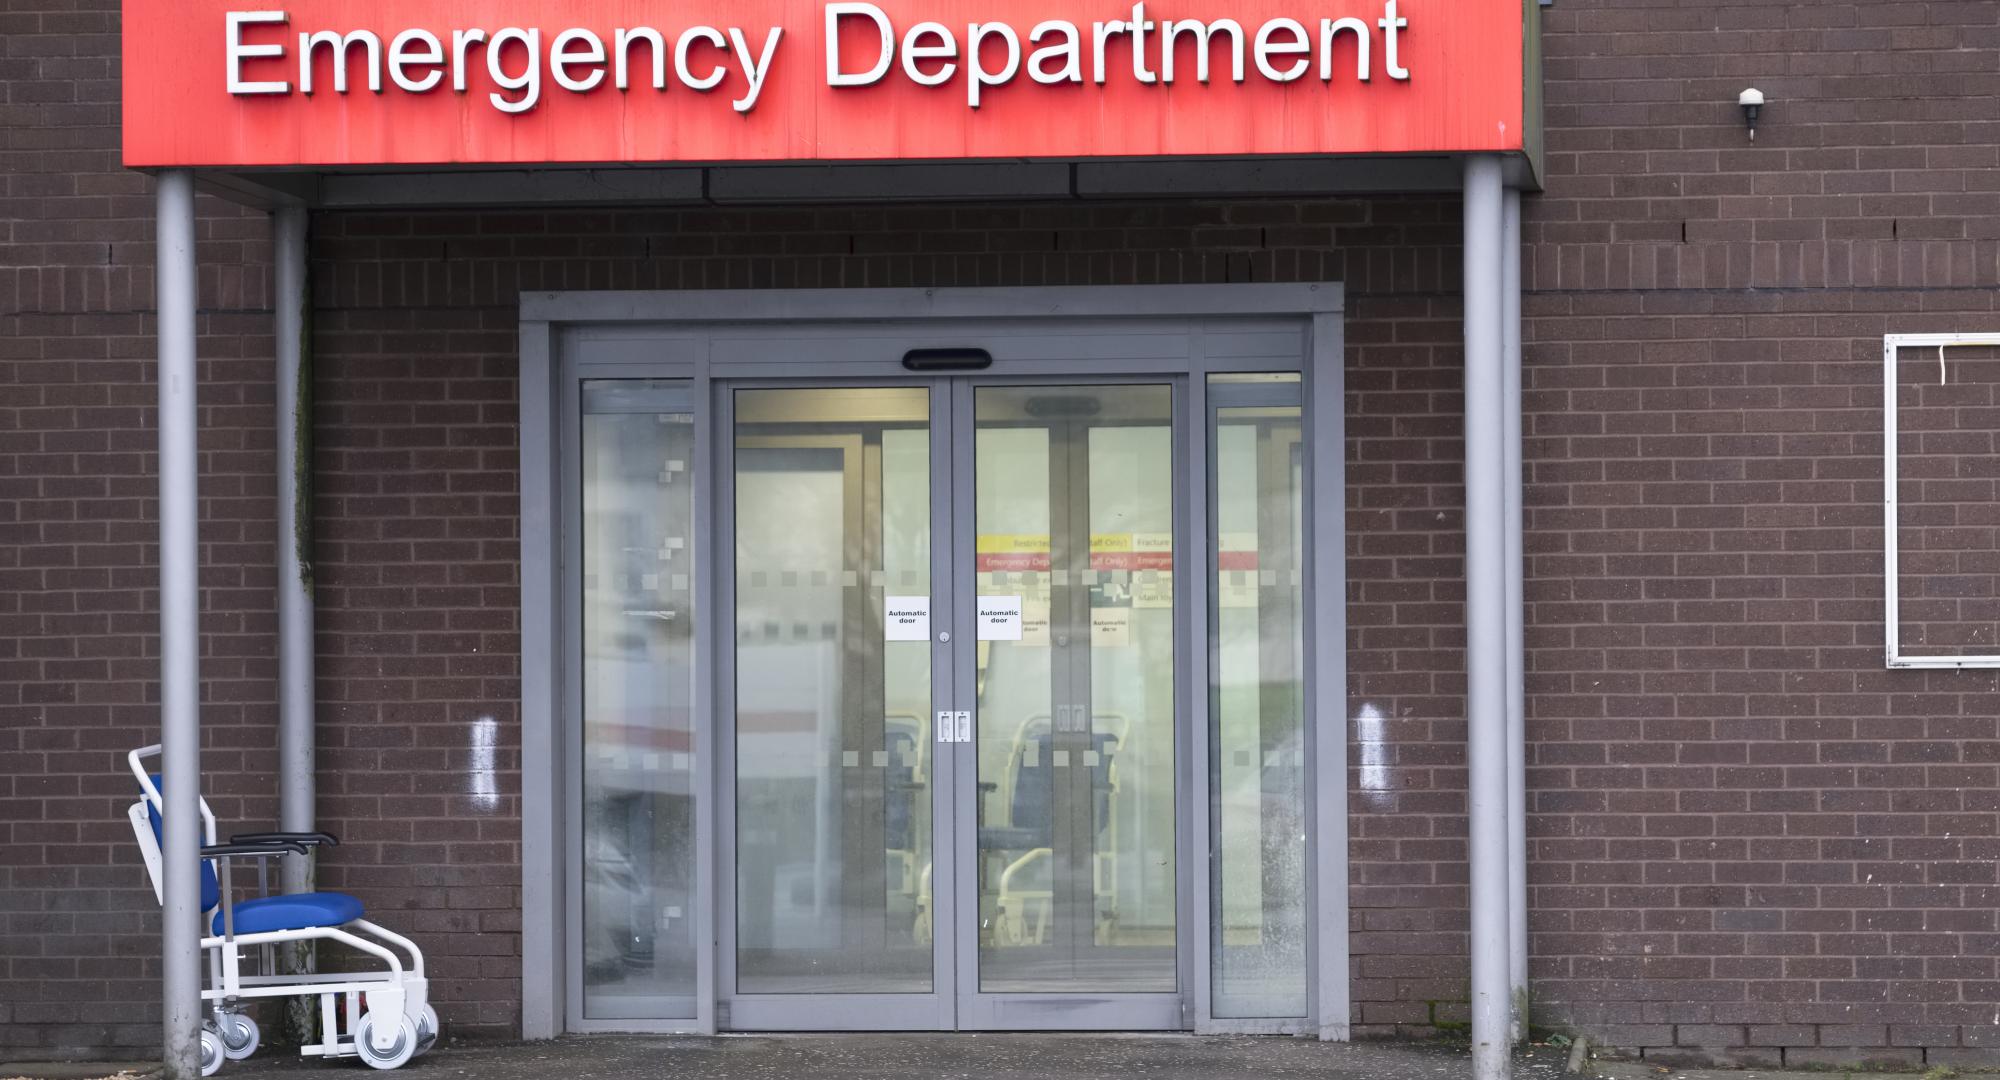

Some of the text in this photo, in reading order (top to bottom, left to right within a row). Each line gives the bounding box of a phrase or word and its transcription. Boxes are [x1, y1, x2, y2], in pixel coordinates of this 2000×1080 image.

[226, 0, 1410, 113] Emergency Department
[1137, 538, 1170, 547] Fracture
[986, 557, 1031, 568] Emergency
[1137, 556, 1171, 568] Emergen
